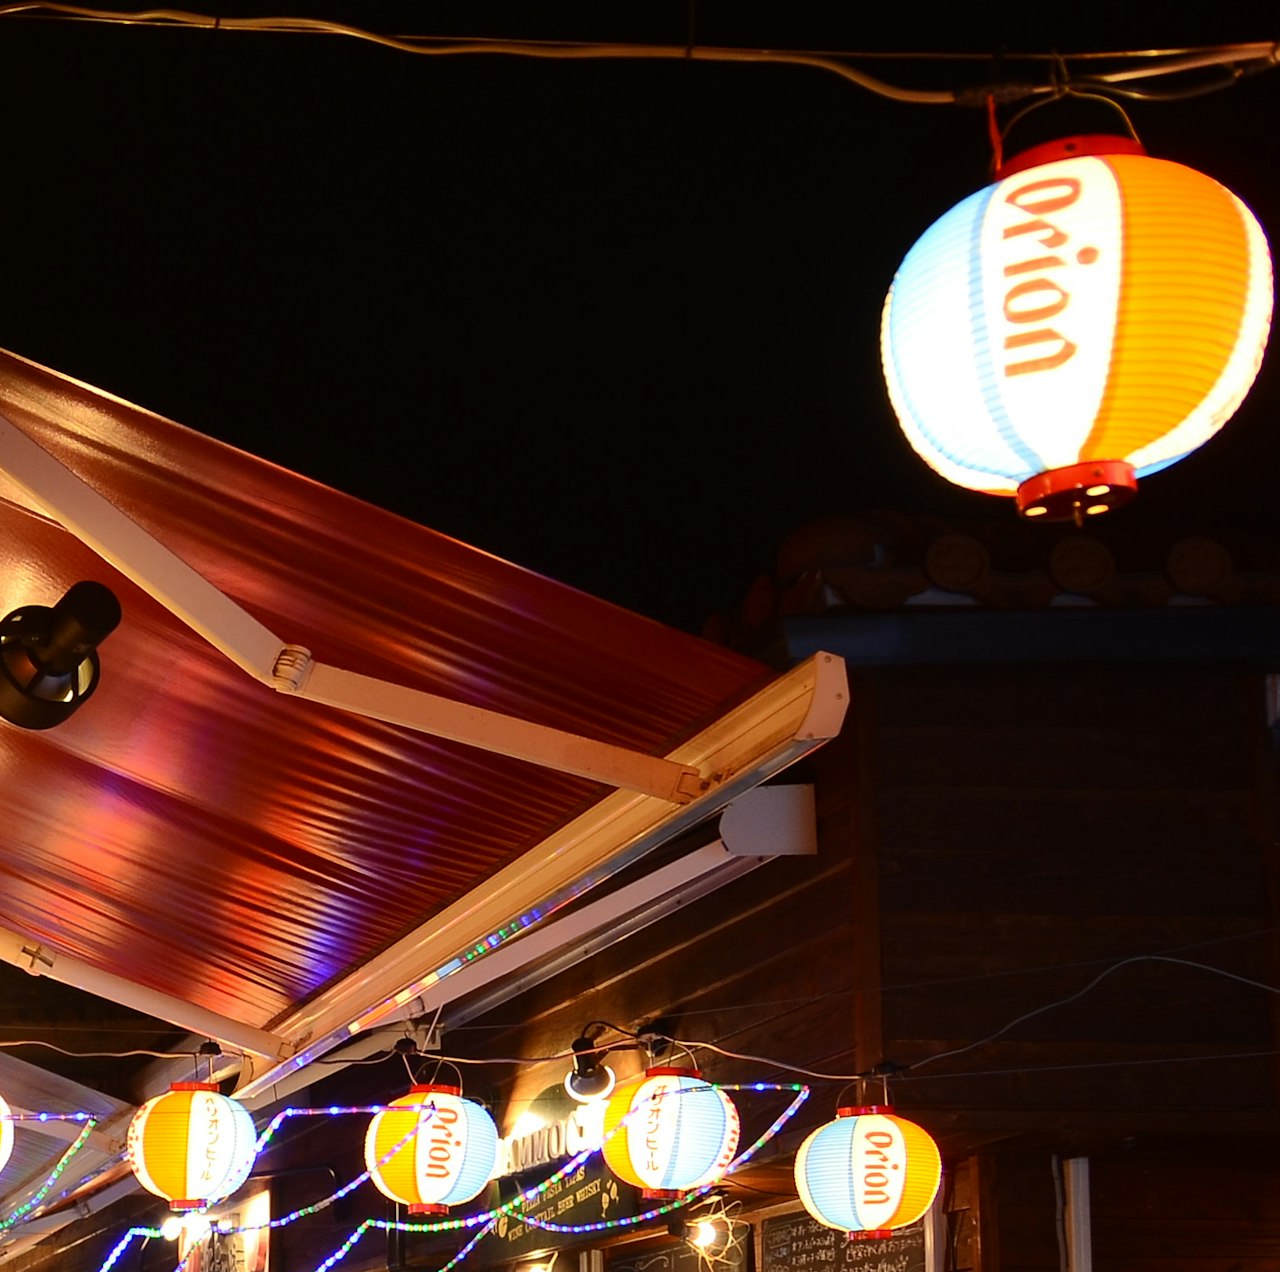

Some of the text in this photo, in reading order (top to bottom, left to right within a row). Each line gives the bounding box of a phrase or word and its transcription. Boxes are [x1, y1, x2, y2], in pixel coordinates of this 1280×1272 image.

[1003, 177, 1099, 378] Orion
[425, 1106, 460, 1178] Orion
[863, 1131, 900, 1205] Orion
